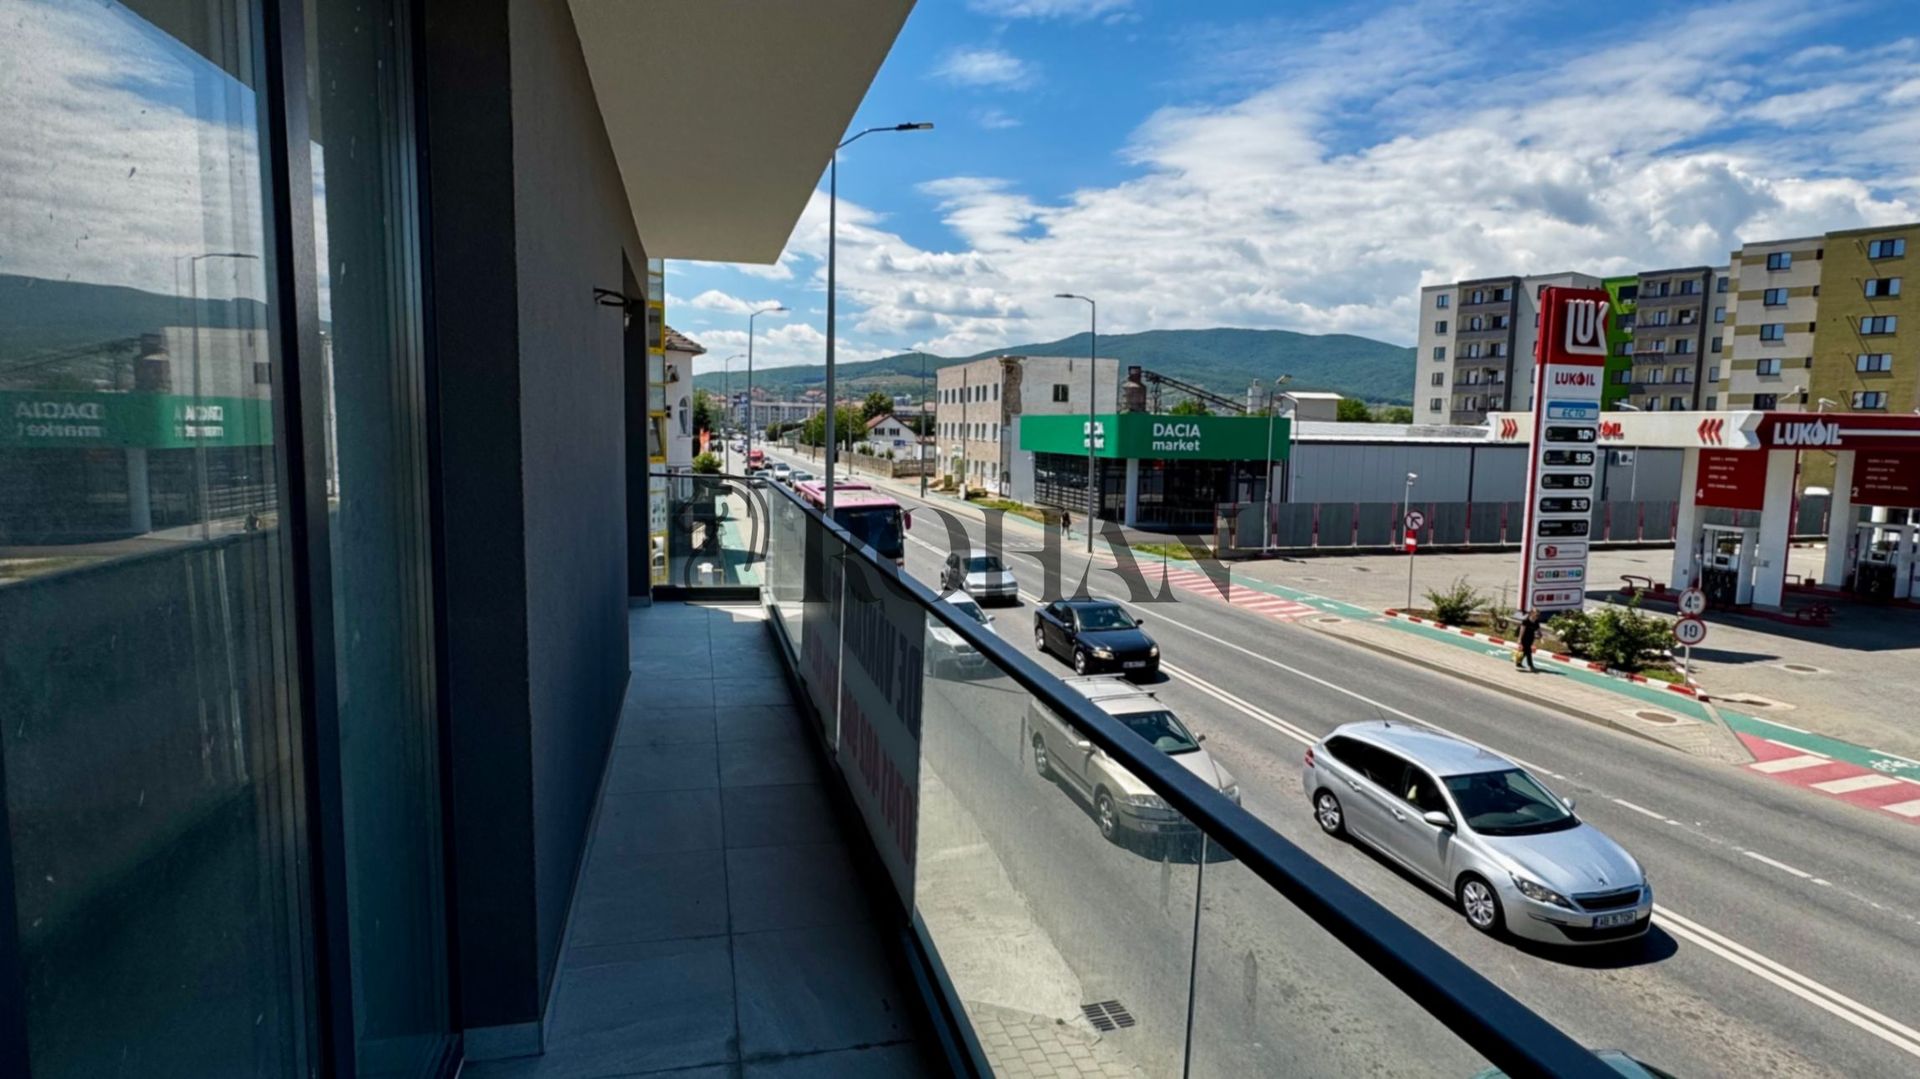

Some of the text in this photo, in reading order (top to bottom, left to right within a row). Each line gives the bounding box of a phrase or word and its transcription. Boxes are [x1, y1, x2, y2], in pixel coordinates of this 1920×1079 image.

[1555, 372, 1596, 386] LUKOIL
[1561, 408, 1586, 417] ECTO
[1152, 423, 1200, 437] DACIA
[1773, 418, 1842, 446] LUKOIL
[1152, 440, 1200, 451] market
[1697, 489, 1704, 499] 4
[1852, 486, 1859, 497] 2
[1685, 595, 1692, 609] 4
